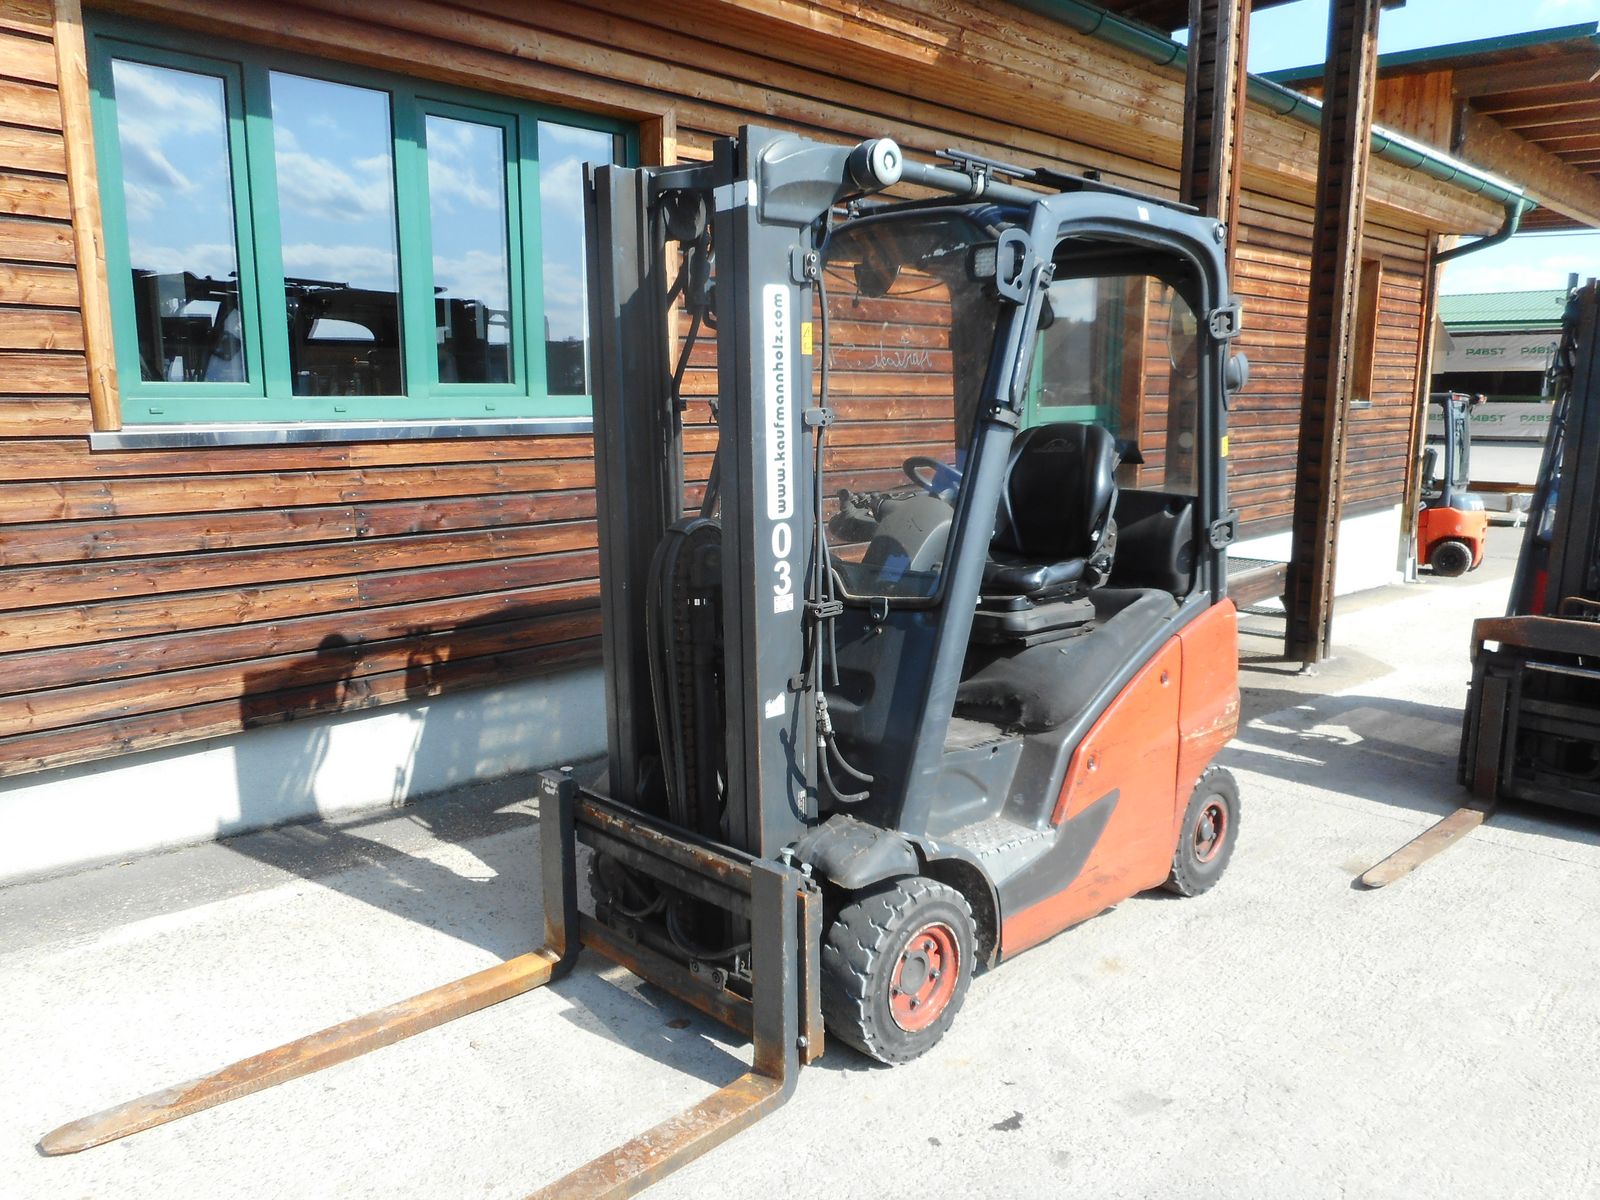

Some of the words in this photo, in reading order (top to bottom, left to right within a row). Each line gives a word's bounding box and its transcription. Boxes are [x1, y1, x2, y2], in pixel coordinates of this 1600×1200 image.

[1465, 347, 1506, 356] PABST
[1520, 345, 1554, 354] PABS
[772, 293, 787, 514] www.kaufmannholz.com
[1520, 414, 1553, 422] PABS
